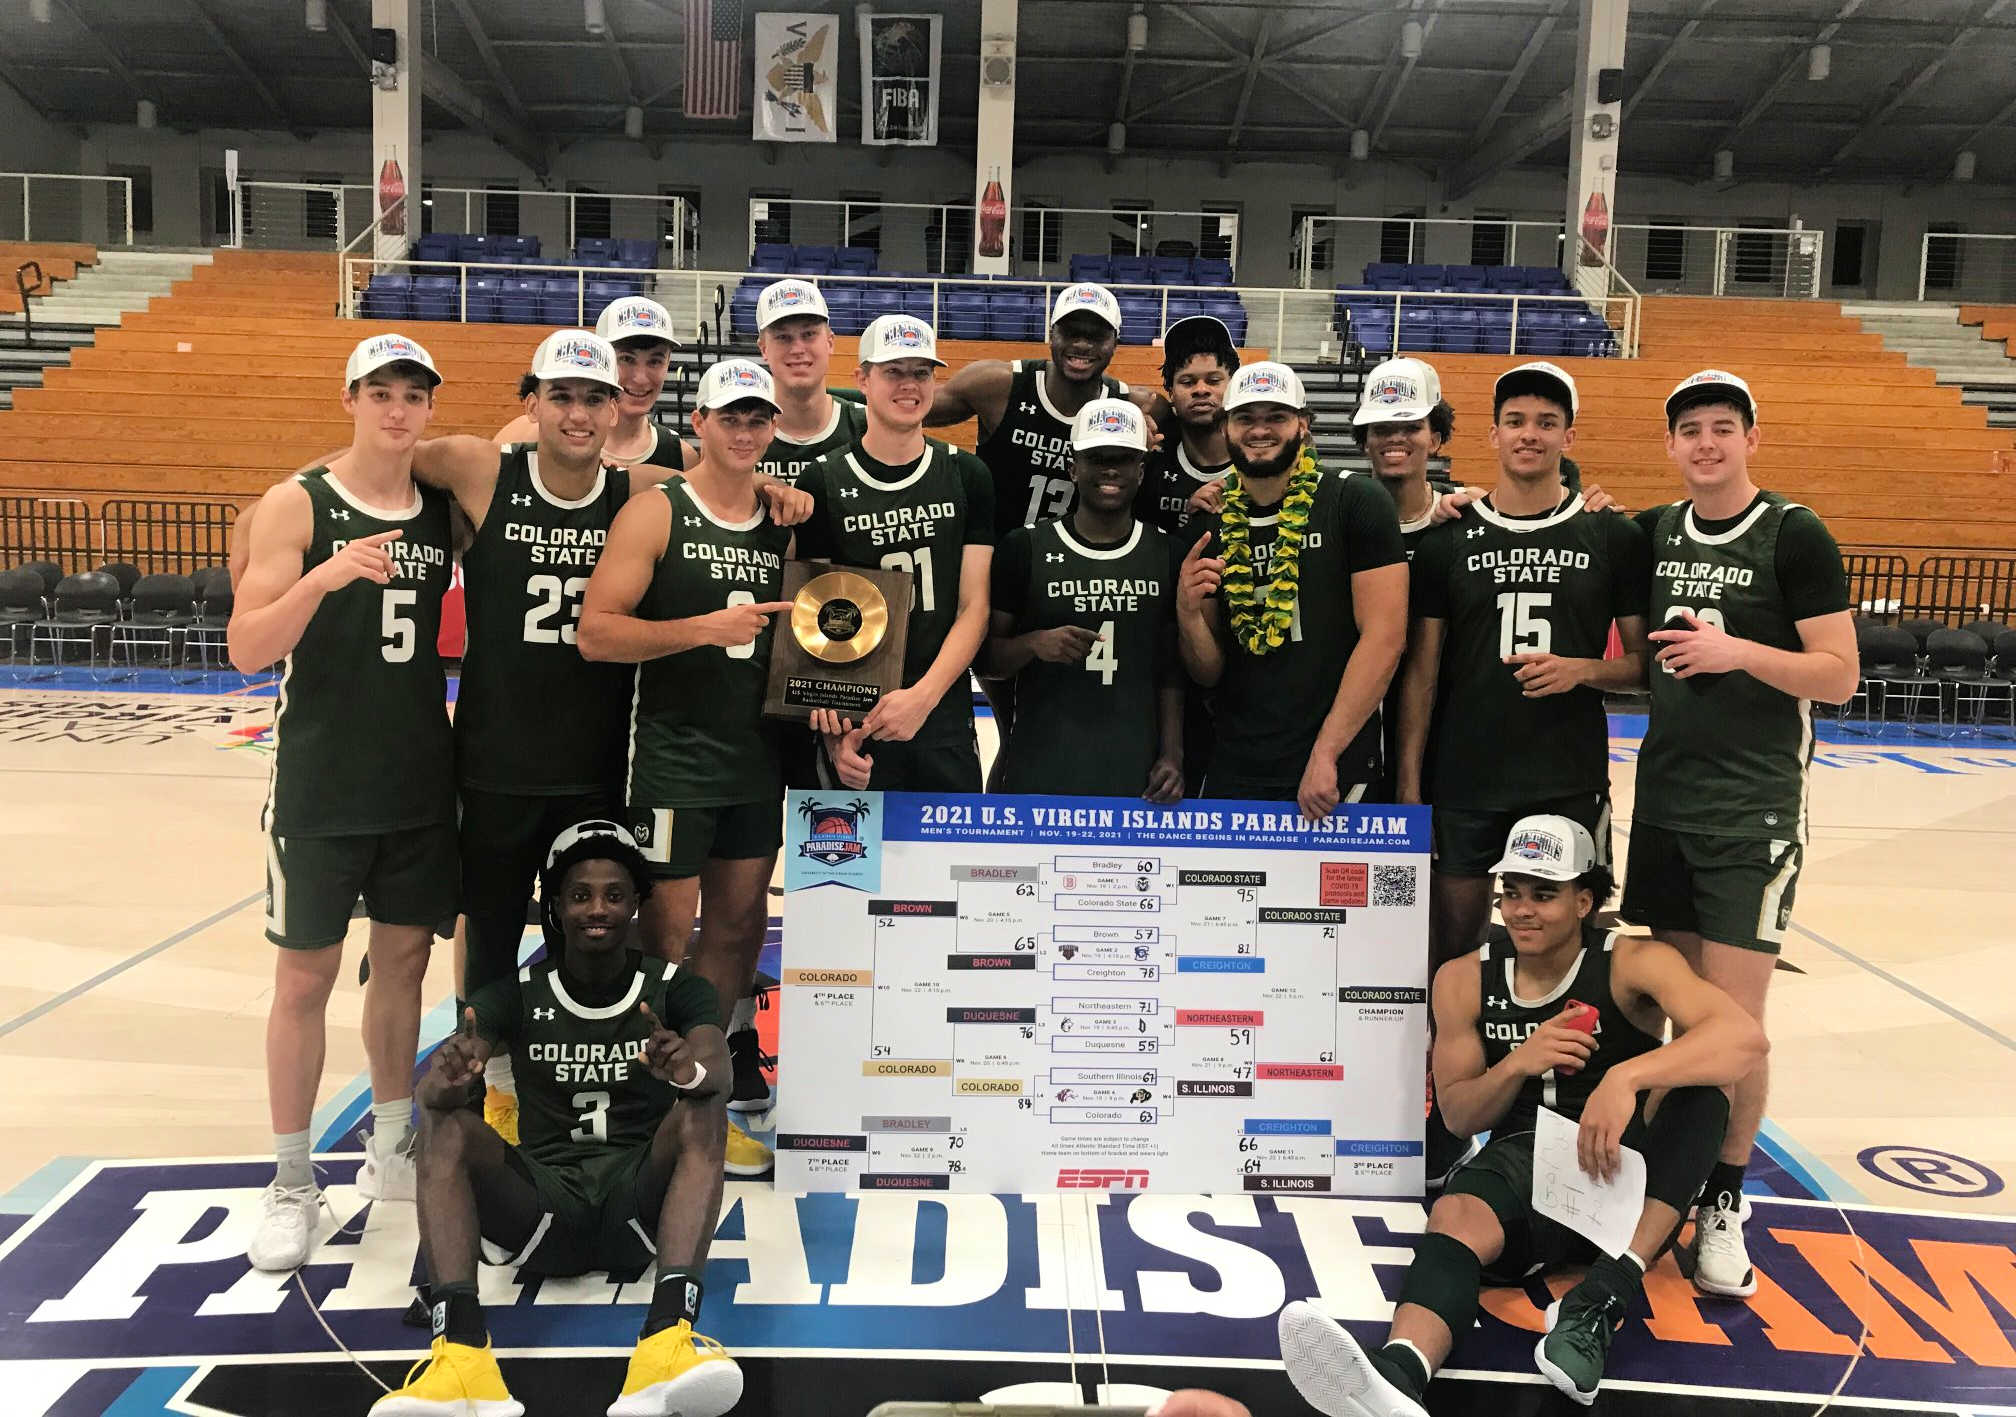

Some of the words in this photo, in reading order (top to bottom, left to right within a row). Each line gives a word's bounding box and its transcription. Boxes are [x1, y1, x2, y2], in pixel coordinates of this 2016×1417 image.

[882, 88, 920, 109] FIBA
[1011, 428, 1074, 455] COLOR
[752, 461, 812, 477] COLO
[843, 502, 956, 533] COLORADO
[505, 522, 607, 547] COLORAD
[871, 521, 936, 546] STATE
[332, 540, 444, 567] CORADO
[530, 546, 597, 566] STATE
[683, 542, 780, 570] COLORADO
[1467, 548, 1590, 572] COLORADO
[710, 563, 769, 585] STATE
[1494, 566, 1561, 584] STATE
[1655, 561, 1754, 587] COLORADO
[1047, 579, 1160, 598] COLORADO
[1671, 580, 1724, 600] STATE
[523, 574, 590, 644] 23
[1074, 596, 1138, 612] STATE
[381, 589, 417, 663] 5
[1496, 592, 1552, 659] 15
[1085, 621, 1119, 686] 4
[789, 679, 813, 689] 2021
[815, 681, 878, 696] CHAMPIONS
[920, 805, 973, 825] 2021
[981, 807, 1024, 826] U.S.
[1032, 808, 1114, 828] VIRGIN
[1122, 809, 1223, 831] ISLANDS
[1231, 813, 1349, 834] PARADISE
[1356, 816, 1408, 835] JAM
[921, 827, 953, 835] MEN'S
[956, 828, 1025, 836] TOURNAMENT
[1039, 829, 1062, 838] NOV.
[1066, 830, 1096, 839] 19-22,
[1099, 831, 1121, 839] 2021
[1159, 832, 1193, 841] DANCE
[1235, 834, 1246, 842] IN
[1249, 834, 1299, 843] PARADISE
[1313, 837, 1410, 846] PARADISEJAM.COM
[1093, 862, 1122, 870] Bradley
[1137, 861, 1153, 873] 60
[969, 868, 1018, 878] BRADLEY
[1185, 874, 1233, 883] COLORADO
[1234, 875, 1261, 884] STATE
[1016, 883, 1035, 897] 62
[1237, 888, 1255, 903] 95
[893, 903, 932, 913] BROWN
[1078, 899, 1114, 907] Colorado
[1117, 899, 1138, 907] State
[1139, 899, 1154, 910] 66
[1264, 911, 1312, 920] COLORADO
[1313, 912, 1341, 921] STATE
[878, 918, 895, 928] 52
[1134, 929, 1153, 940] 57
[1014, 937, 1036, 951] 65
[1237, 943, 1251, 954] 81
[973, 958, 1012, 968] BROWN
[1193, 961, 1251, 970] CREIGHTON
[799, 973, 857, 982] COLORADO
[1087, 969, 1126, 978] Creighton
[1138, 967, 1155, 979] 78
[1345, 990, 1392, 1000] COLORADO
[1394, 992, 1421, 1000] STATE
[1078, 1002, 1131, 1010] Northeastern
[1138, 1001, 1152, 1013] 71
[963, 1011, 1021, 1021] DUQUESNE
[1186, 1014, 1254, 1023] NORTHEASTERN
[1019, 1027, 1034, 1039] 76
[1230, 1028, 1250, 1046] 59
[1485, 1022, 1540, 1040] COLO
[873, 1046, 891, 1056] 54
[1085, 1041, 1126, 1049] Duquesne
[1138, 1040, 1155, 1052] 55
[555, 1063, 629, 1083] STATE
[878, 1065, 937, 1074] COLORADO
[1233, 1066, 1252, 1079] 47
[1267, 1069, 1334, 1077] NORTHEASTERN
[961, 1083, 1020, 1092] COLORADO
[1182, 1085, 1191, 1093] S.
[1193, 1085, 1236, 1094] ILLINOIS
[570, 1091, 611, 1144] 3
[1139, 1110, 1153, 1123] 63
[882, 1119, 932, 1129] BRADLEY
[1259, 1122, 1318, 1132] CREIGHTON
[793, 1138, 851, 1148] DUQUESNE
[948, 1136, 964, 1150] 70
[1238, 1137, 1258, 1152] 66
[1351, 1143, 1409, 1153] CREIGHTON
[821, 1158, 850, 1166] PLACE
[947, 1160, 961, 1173] 78
[1244, 1159, 1261, 1174] 64
[876, 1177, 934, 1187] DUQUESNE
[1056, 1169, 1150, 1189] ESPN
[1260, 1180, 1271, 1188] S.
[1272, 1180, 1315, 1189] ILLINOIS
[25, 1184, 1448, 1325] PAADISE
